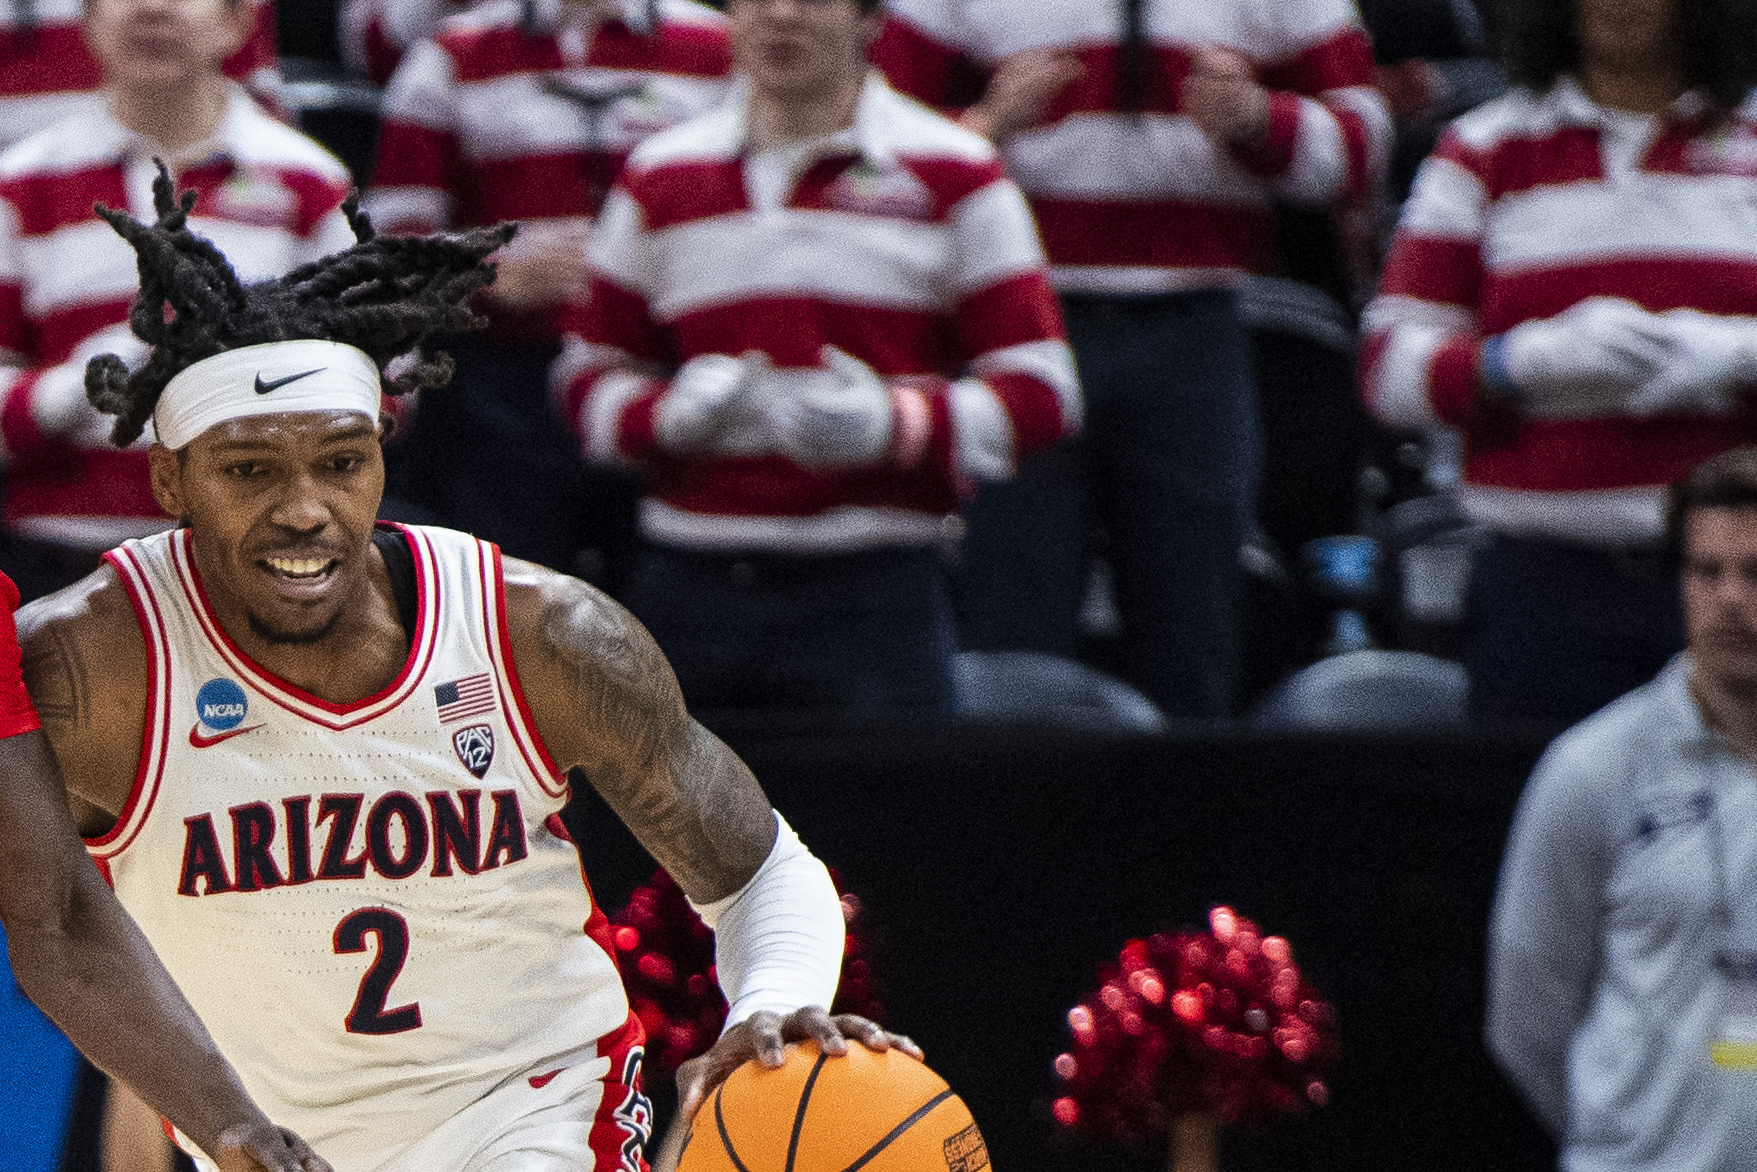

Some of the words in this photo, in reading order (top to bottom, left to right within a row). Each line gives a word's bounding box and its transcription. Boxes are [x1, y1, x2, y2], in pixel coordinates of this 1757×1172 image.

[204, 703, 244, 717] NCAA
[455, 726, 492, 760] PAC
[467, 746, 489, 769] 12
[178, 790, 528, 896] ARIZONA
[332, 906, 423, 1035] 2
